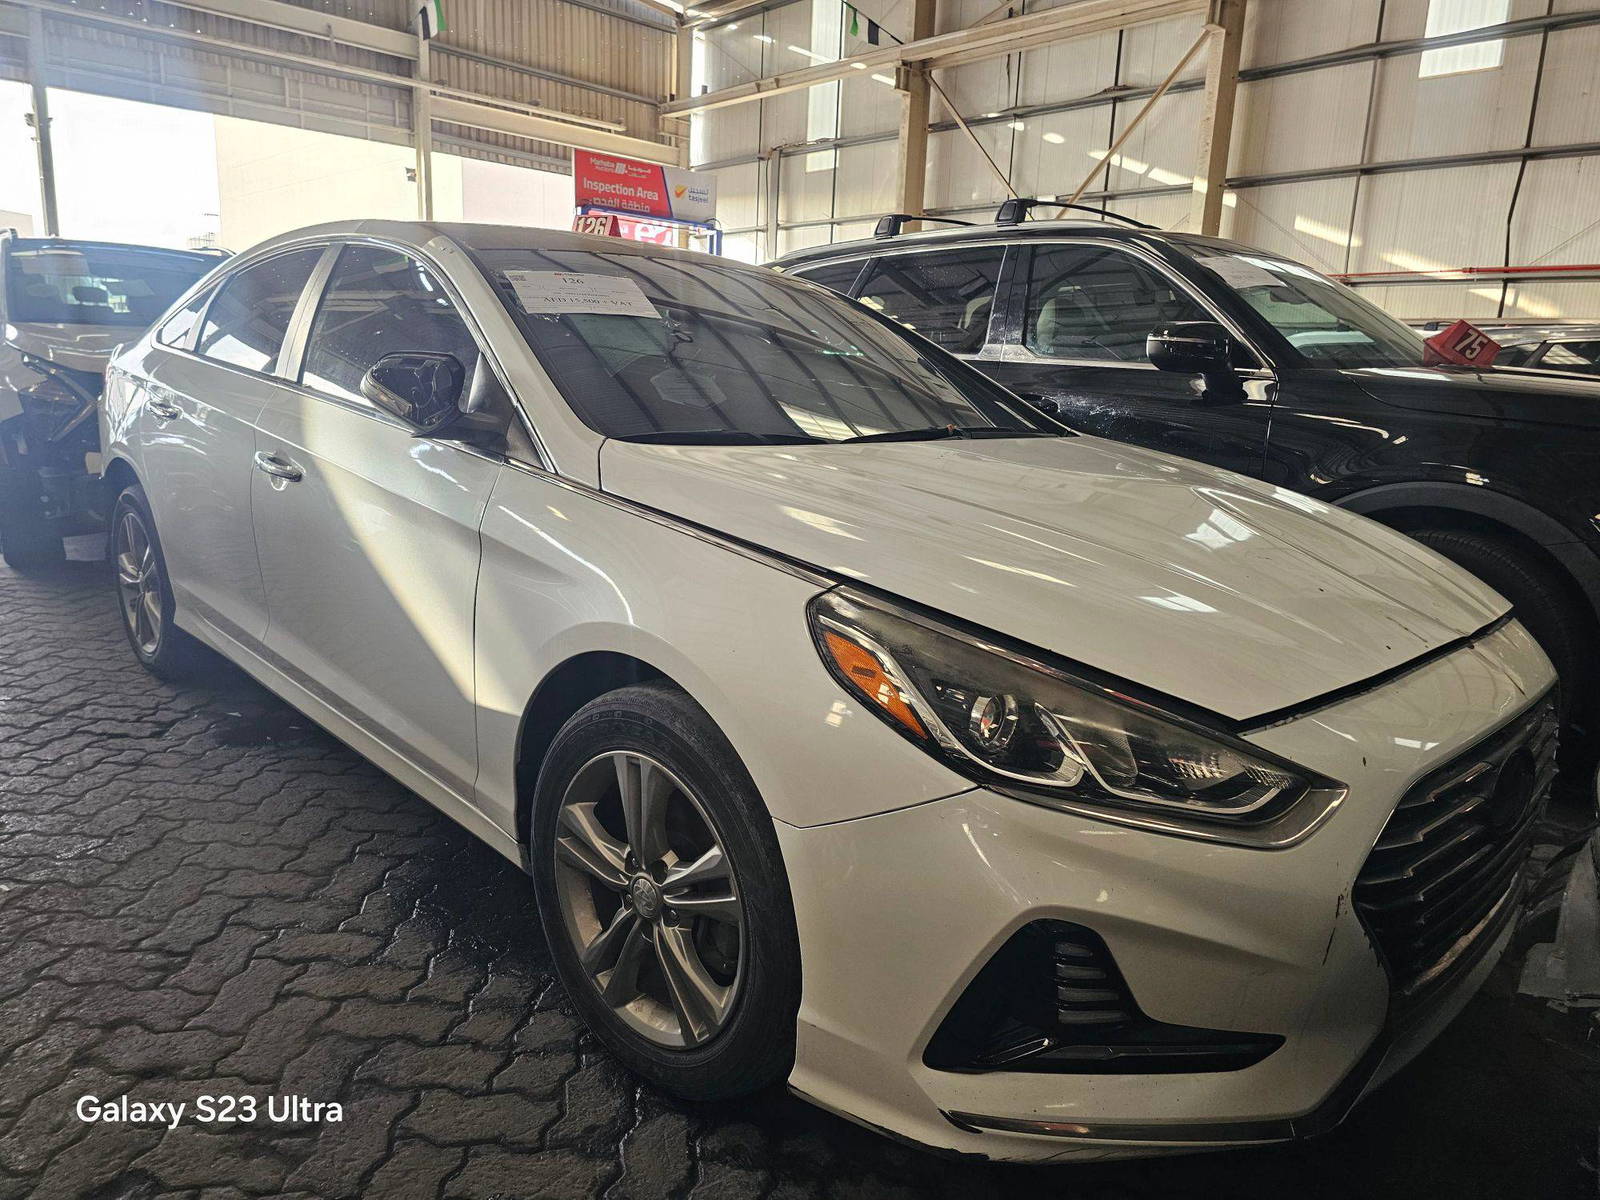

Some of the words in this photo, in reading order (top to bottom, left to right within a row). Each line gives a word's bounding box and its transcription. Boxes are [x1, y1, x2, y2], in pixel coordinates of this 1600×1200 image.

[583, 177, 636, 198] Inspection
[638, 187, 659, 201] Area
[577, 217, 606, 236] 126
[562, 277, 584, 285] 126
[1454, 328, 1489, 359] 75
